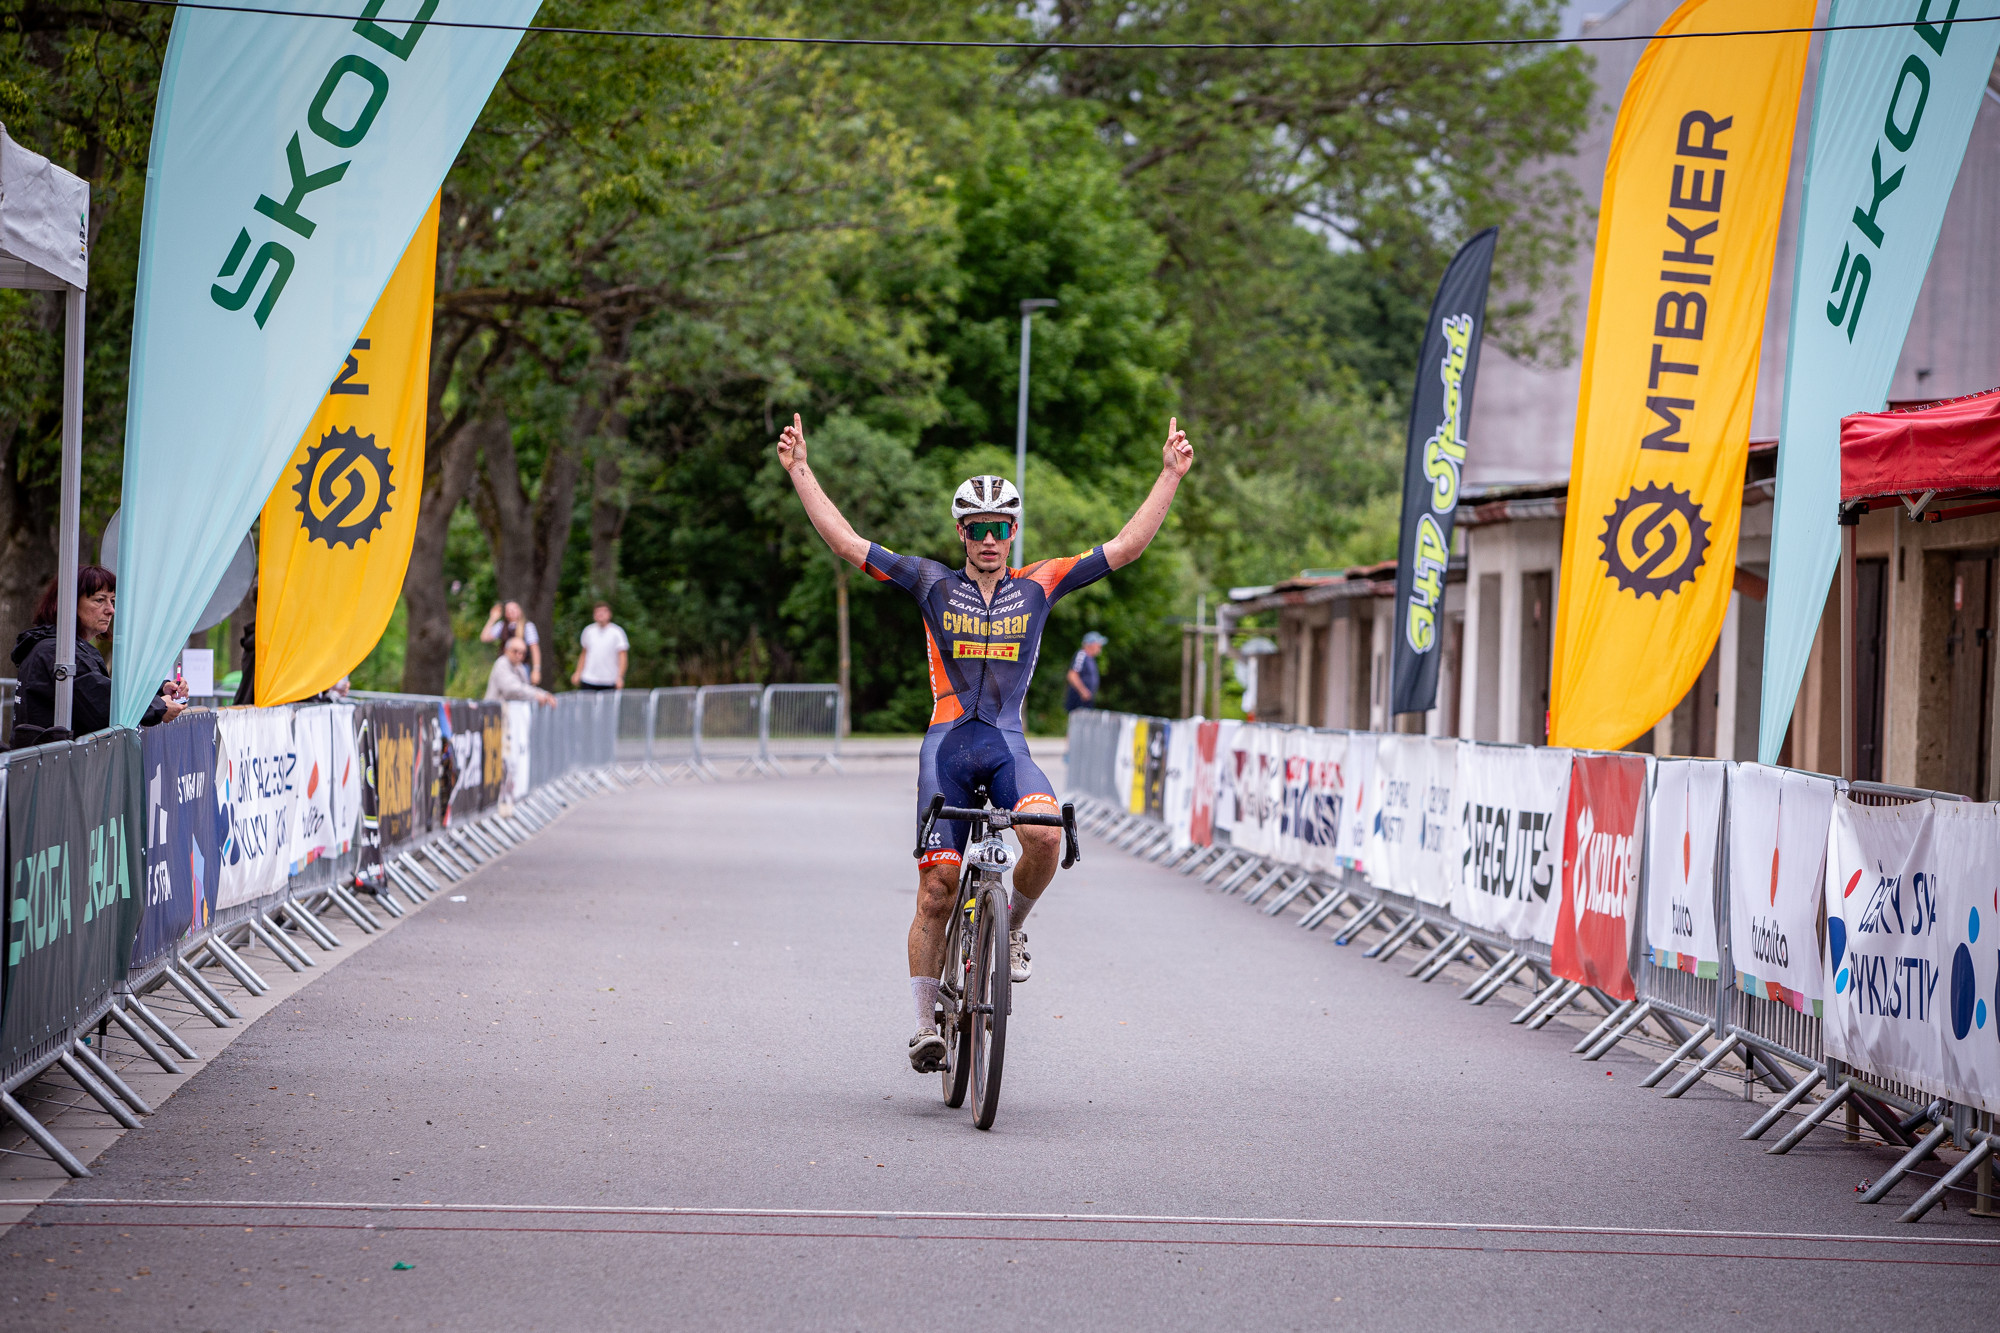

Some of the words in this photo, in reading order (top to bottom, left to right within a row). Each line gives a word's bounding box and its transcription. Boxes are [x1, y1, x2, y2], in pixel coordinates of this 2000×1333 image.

[1640, 109, 1733, 452] MTBIKER
[947, 598, 987, 616] SANTA
[988, 598, 1028, 616] CRUZ
[959, 643, 1015, 658] PIRELLI
[1014, 794, 1052, 812] ANTA
[1751, 915, 1789, 969] tubolito
